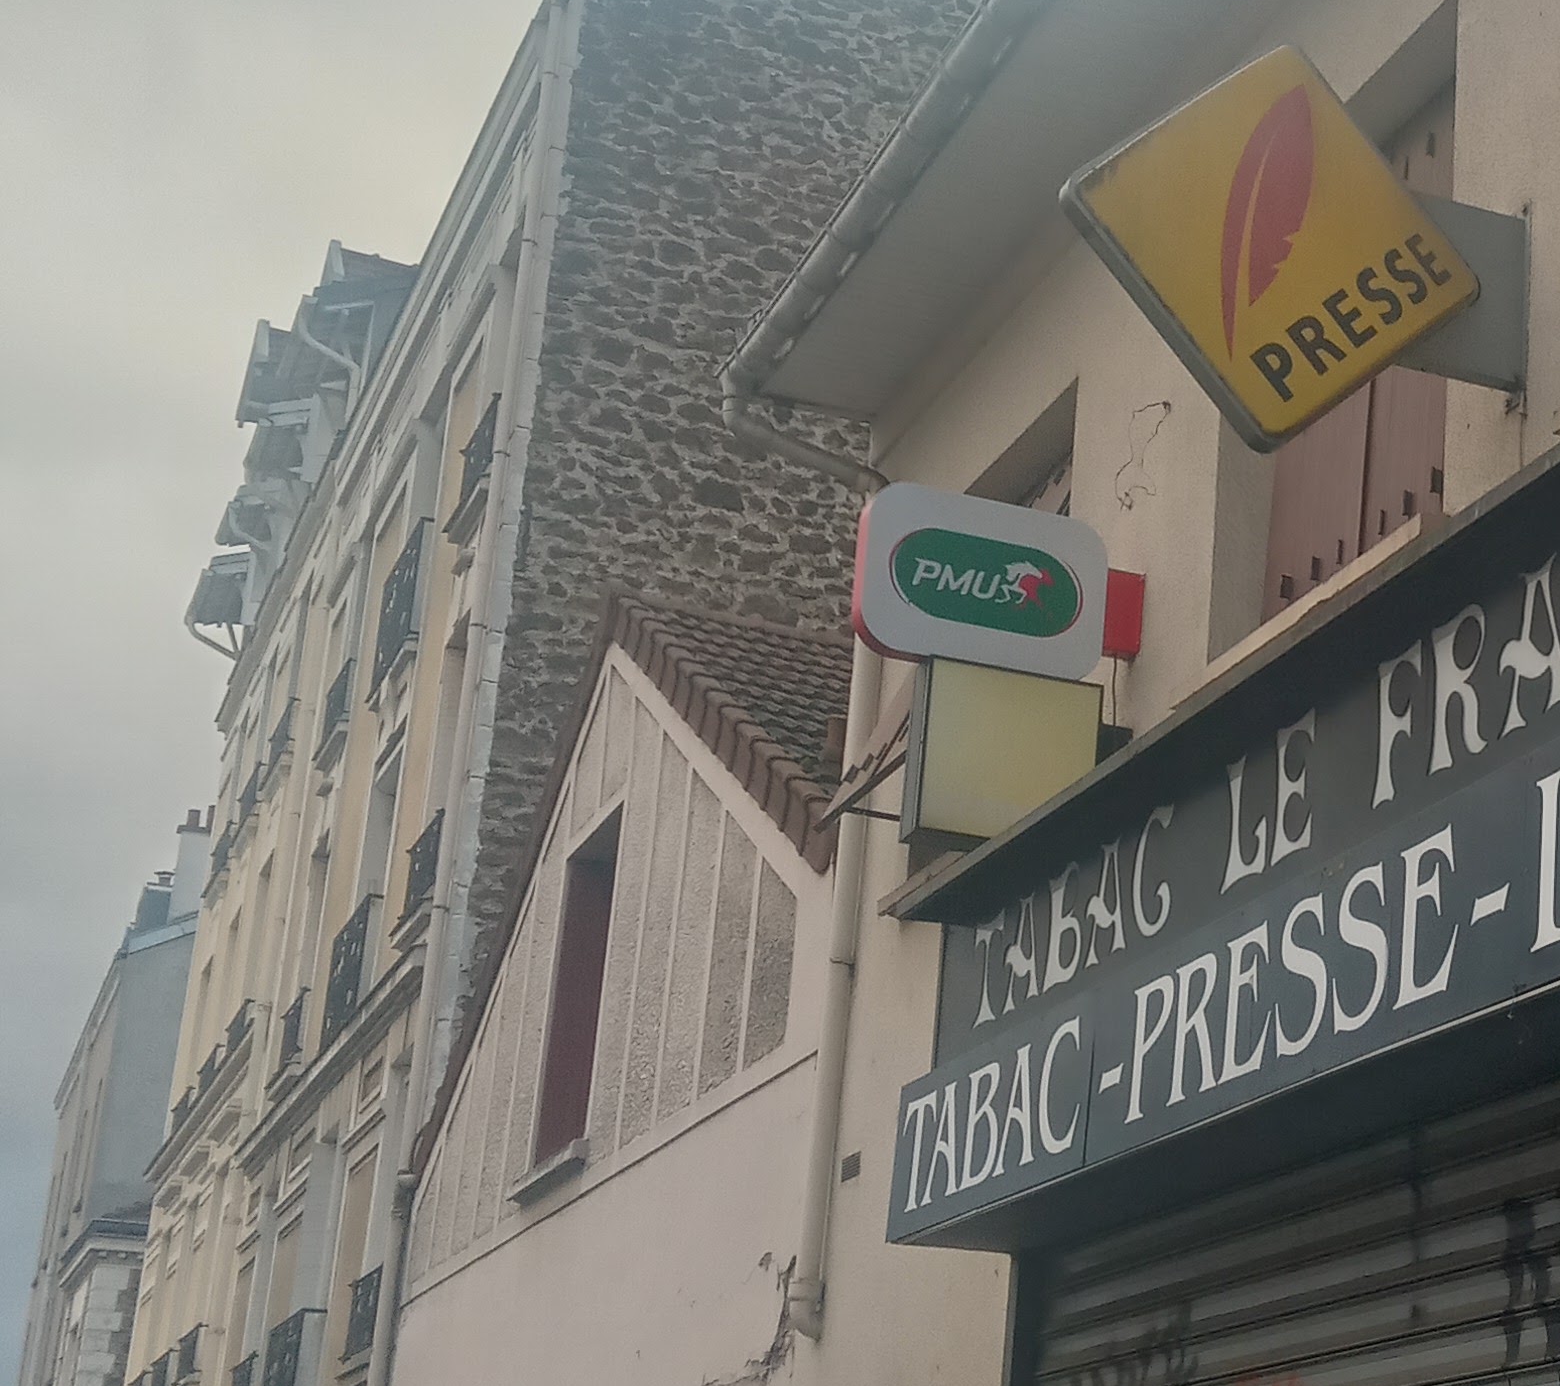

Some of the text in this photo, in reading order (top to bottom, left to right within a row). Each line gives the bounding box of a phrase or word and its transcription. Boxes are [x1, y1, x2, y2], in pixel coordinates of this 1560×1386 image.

[1249, 232, 1453, 404] PRESSE
[911, 557, 1000, 599] PMU
[971, 803, 1176, 1029] TABAC
[1219, 711, 1316, 895] LE
